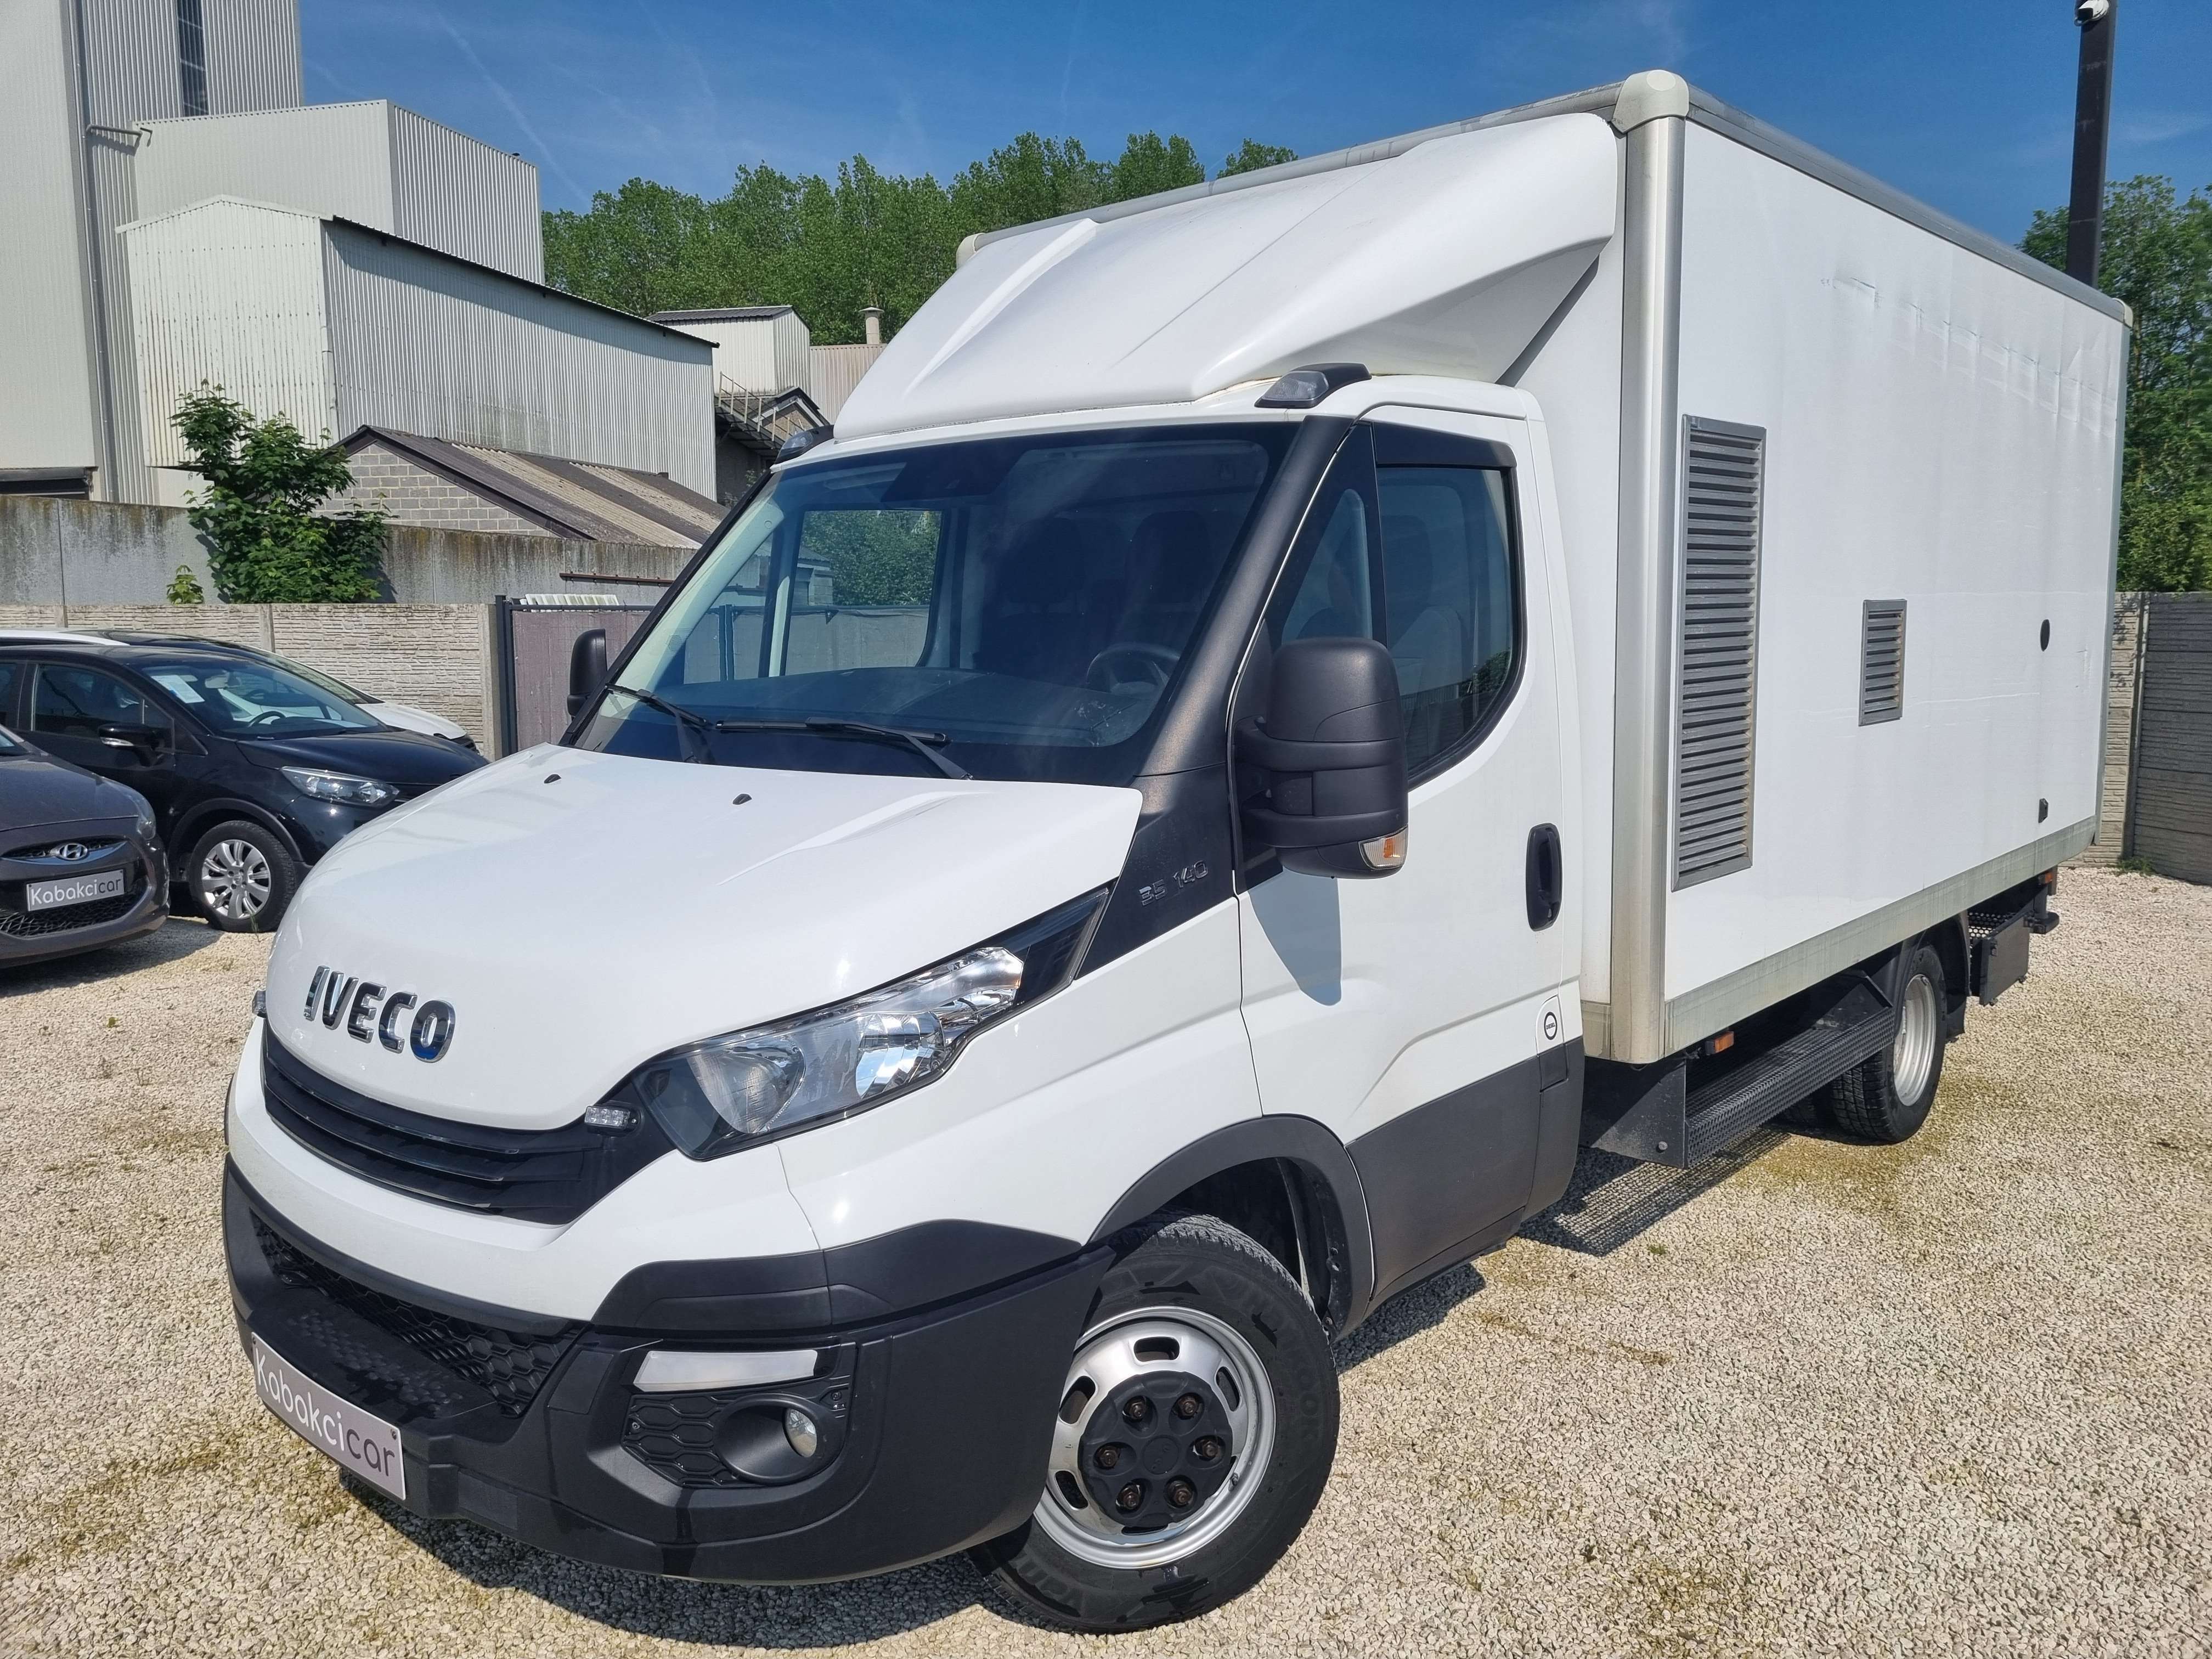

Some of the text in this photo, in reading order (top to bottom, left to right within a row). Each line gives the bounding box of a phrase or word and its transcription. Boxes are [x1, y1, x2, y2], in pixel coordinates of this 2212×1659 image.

[31, 878, 121, 905] Kabakcicar
[1139, 860, 1208, 906] 35 140
[303, 964, 456, 1064] IVECO
[255, 1347, 395, 1477] Kabakcicar
